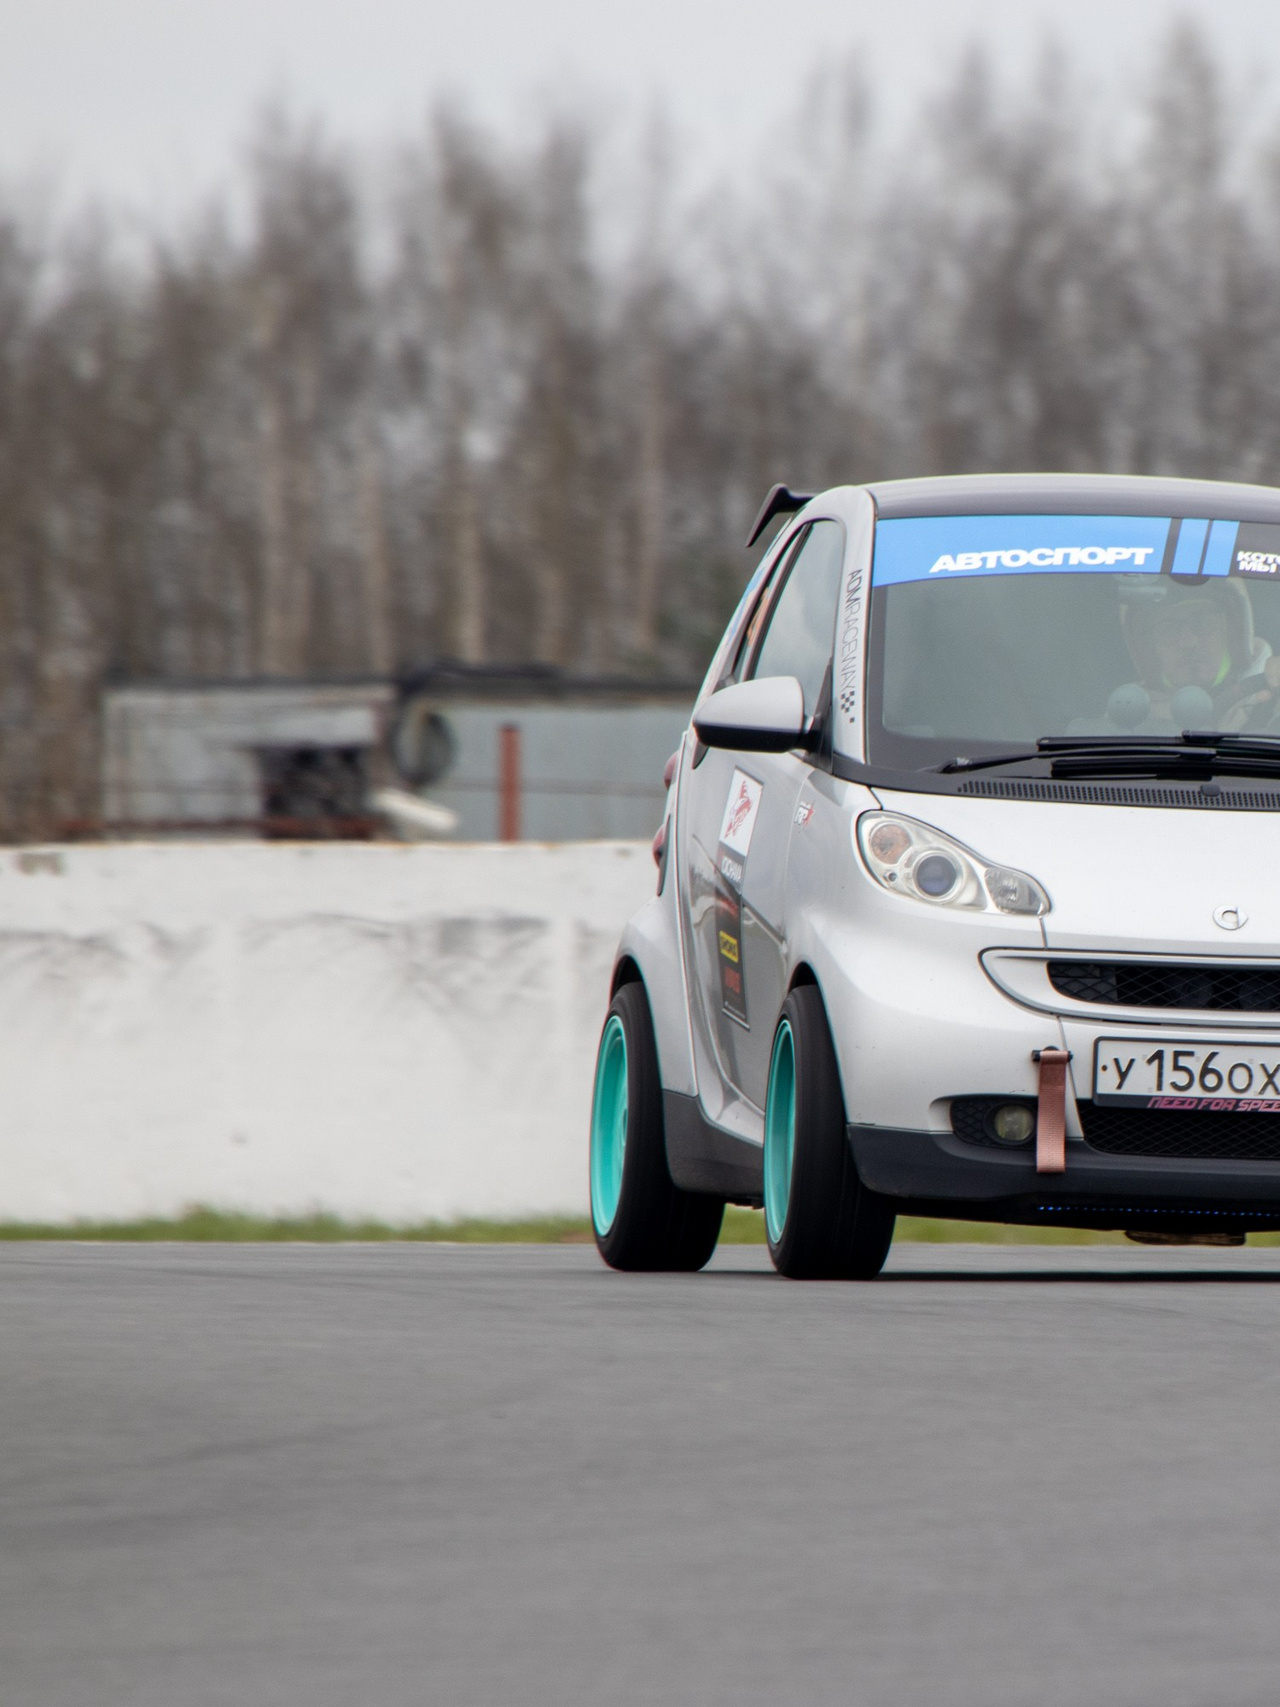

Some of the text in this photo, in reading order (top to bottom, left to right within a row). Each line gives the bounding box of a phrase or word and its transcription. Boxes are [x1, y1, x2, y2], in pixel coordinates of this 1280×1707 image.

[929, 546, 1154, 573] АВТОСПОРТ
[1238, 560, 1277, 574] МЫ
[1147, 1096, 1199, 1110] NEED
[1198, 1098, 1238, 1111] FOR
